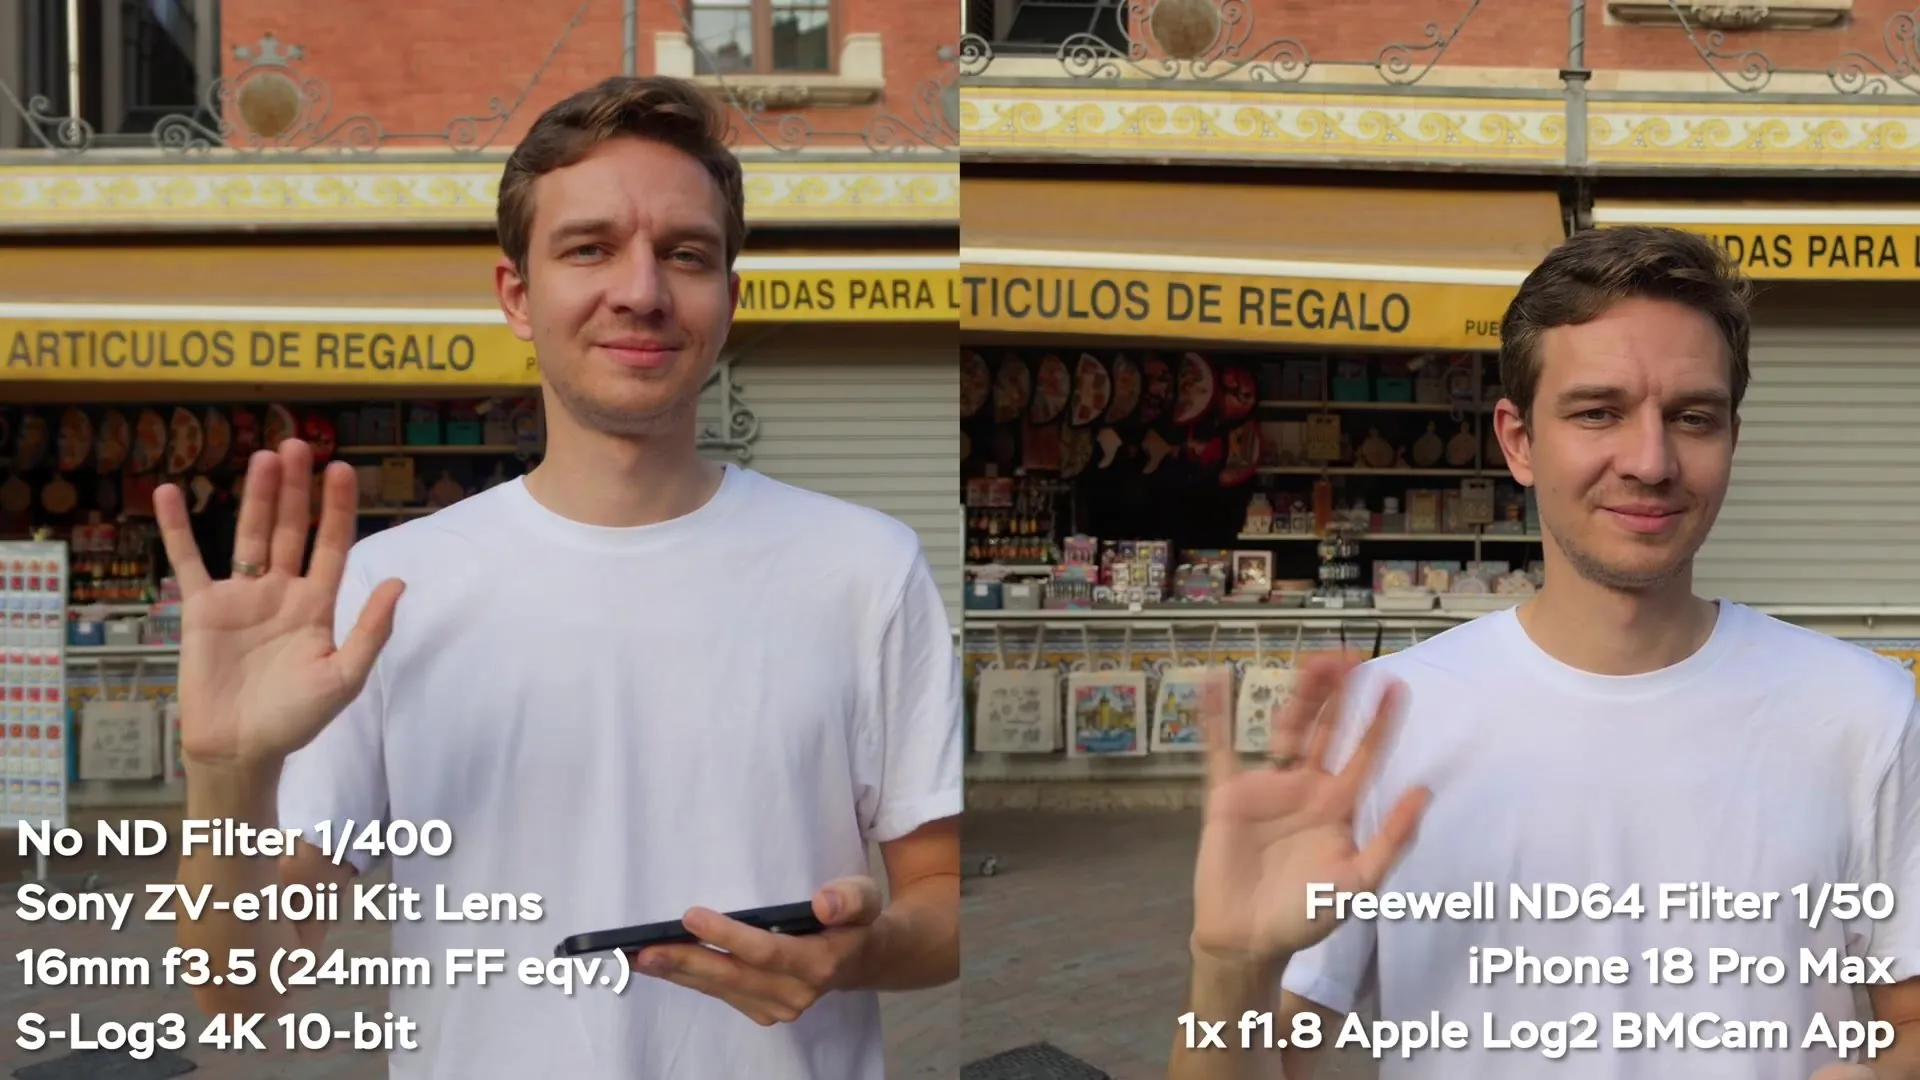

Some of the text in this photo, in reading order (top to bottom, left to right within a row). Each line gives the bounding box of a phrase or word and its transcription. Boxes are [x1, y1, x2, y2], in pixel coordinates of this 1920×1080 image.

[1808, 235, 1900, 268] PARA
[849, 279, 935, 309] PARA
[962, 276, 1411, 333] TICULOS DE REGALO
[6, 330, 475, 372] ARTICULOS DE REGALO
